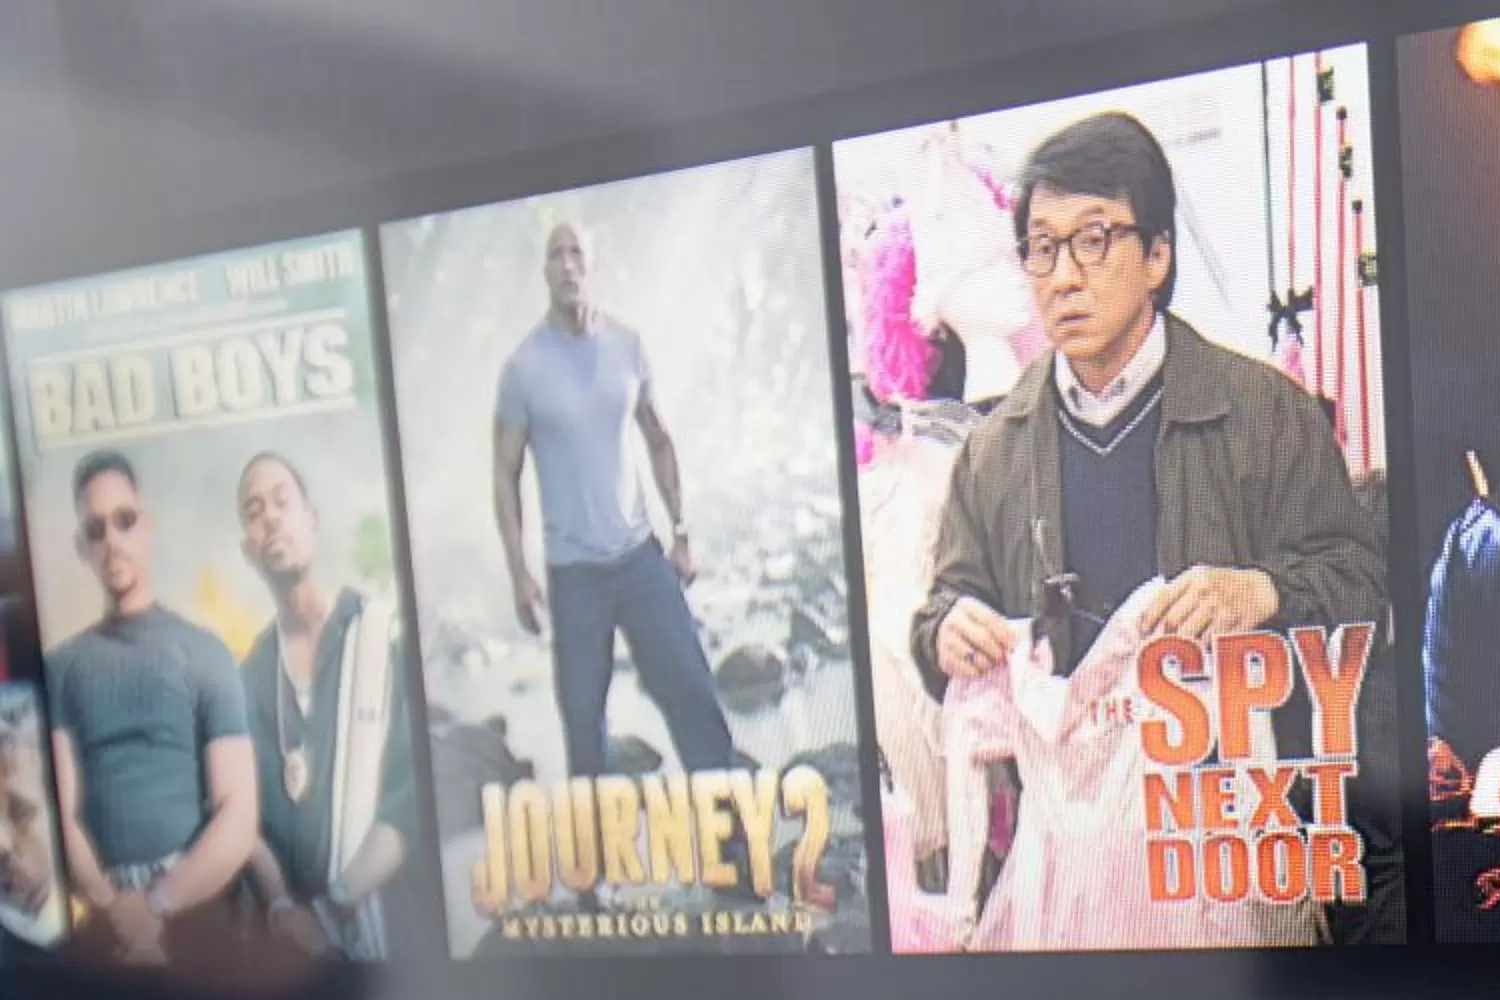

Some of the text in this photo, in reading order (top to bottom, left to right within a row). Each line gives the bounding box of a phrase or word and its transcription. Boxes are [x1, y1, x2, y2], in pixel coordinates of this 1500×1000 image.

[29, 323, 354, 436] BAD BOYS
[1090, 621, 1376, 766] THE SPY
[472, 764, 838, 920] JOURNEY 2
[1143, 762, 1358, 832] NEXT
[1147, 830, 1367, 904] DOOR
[503, 910, 813, 941] MYSTERIOUS ISLAND
